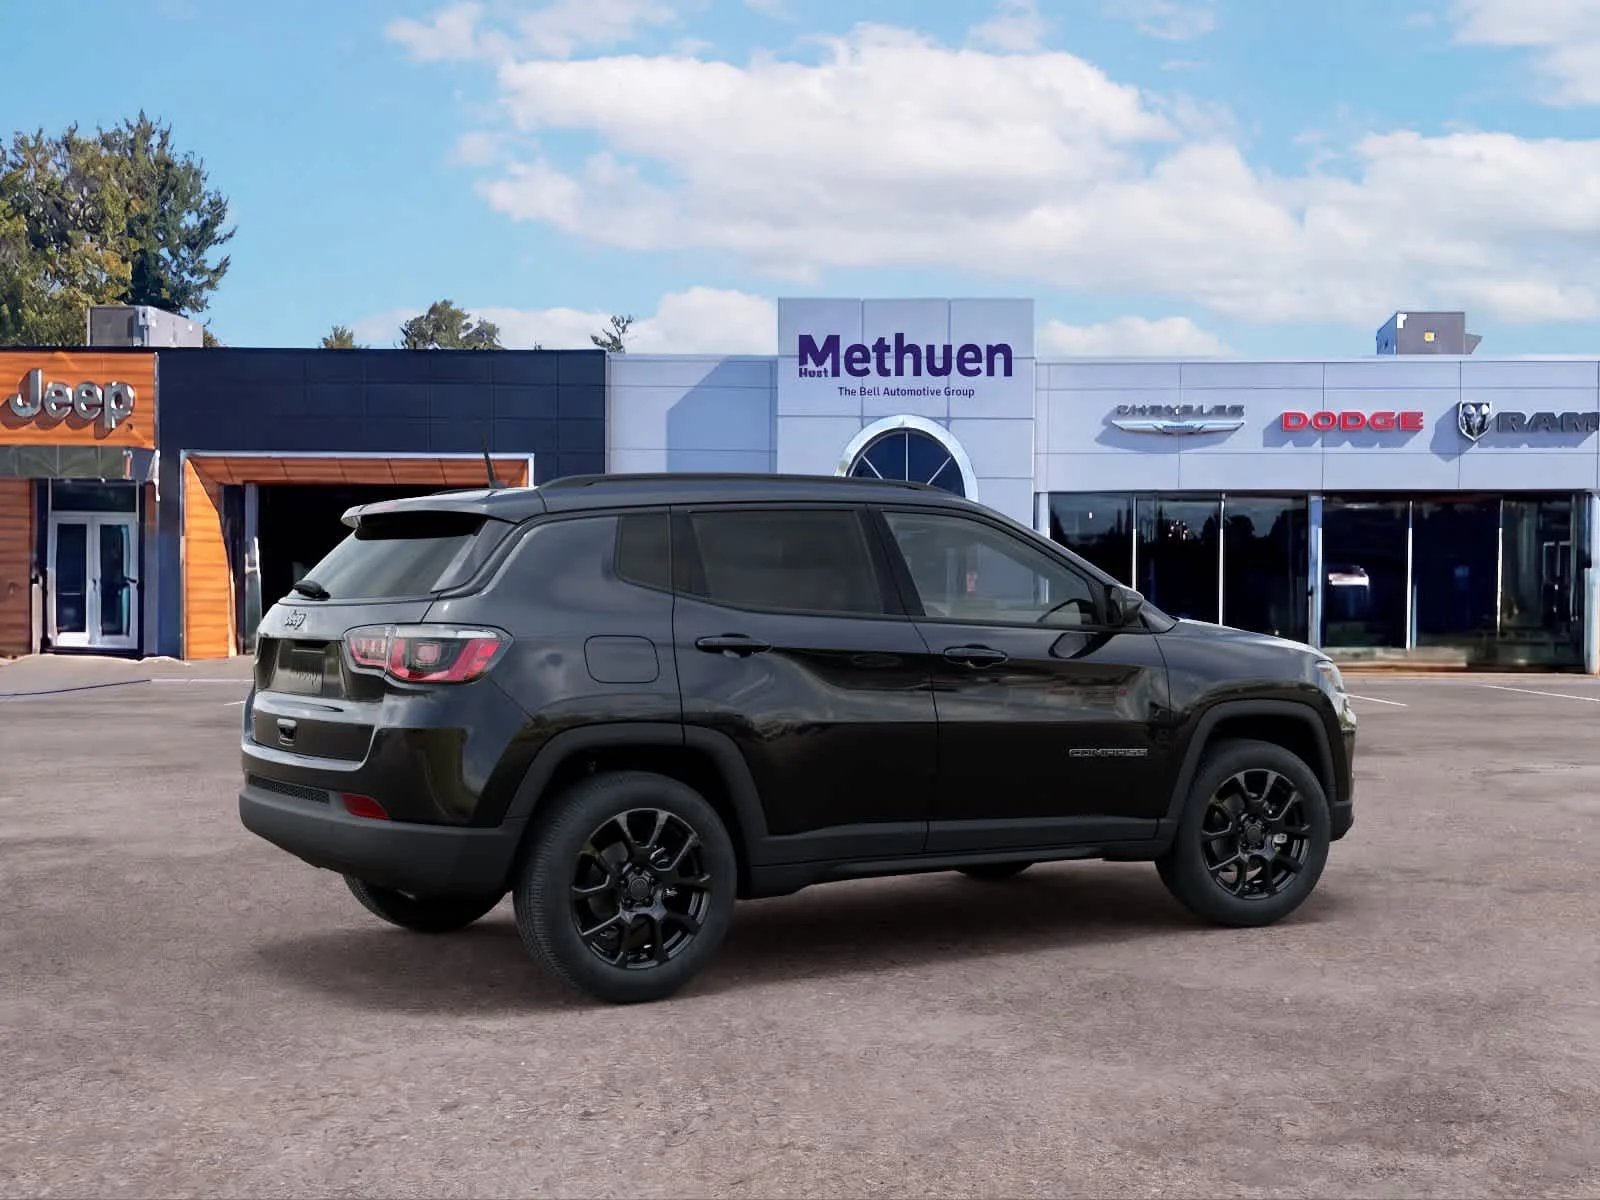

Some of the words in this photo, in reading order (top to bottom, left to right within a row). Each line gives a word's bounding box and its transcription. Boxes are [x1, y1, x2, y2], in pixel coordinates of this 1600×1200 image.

[799, 333, 1013, 377] Methuen
[9, 368, 136, 429] Jeep
[838, 387, 857, 396] The
[860, 387, 880, 396] Bell
[883, 387, 941, 396] Automotive
[944, 387, 975, 399] Group
[1282, 411, 1424, 431] DODGE
[1497, 412, 1600, 432] RAM
